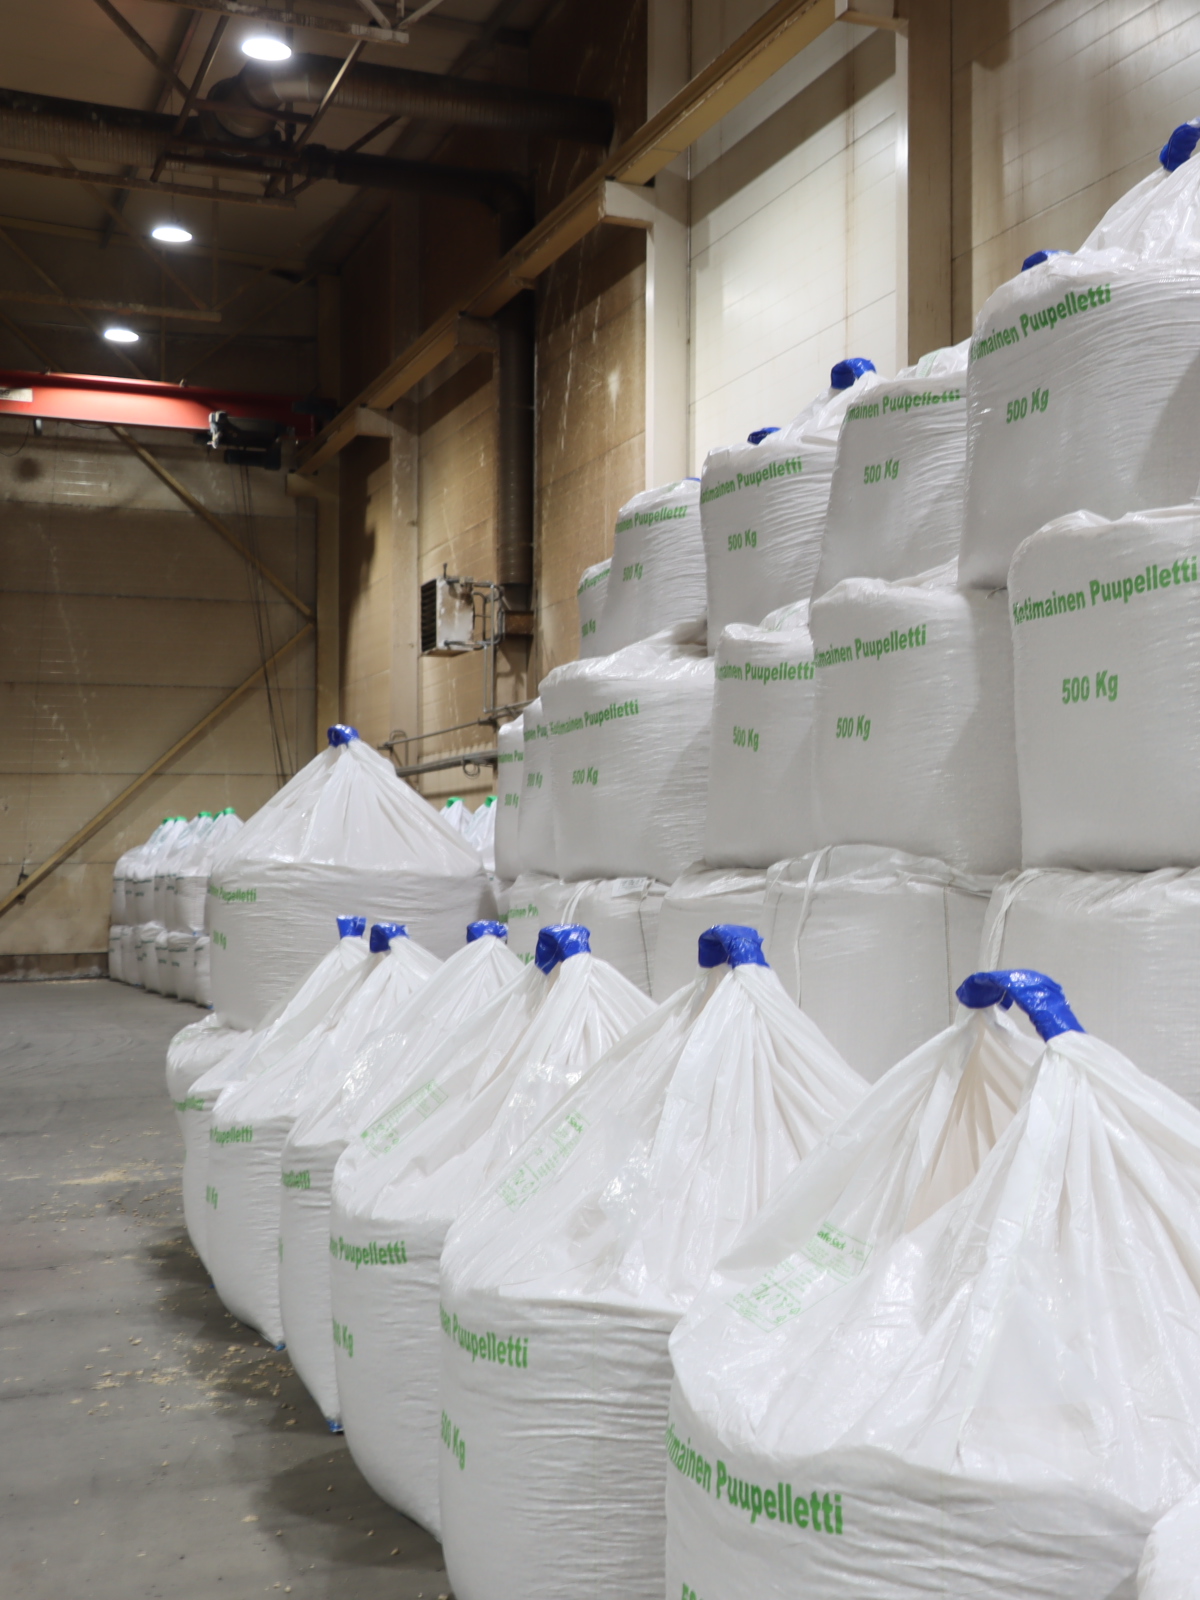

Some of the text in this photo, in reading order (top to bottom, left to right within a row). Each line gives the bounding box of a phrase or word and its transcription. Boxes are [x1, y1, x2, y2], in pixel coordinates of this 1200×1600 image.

[1019, 283, 1112, 337] Puupelletti
[1006, 387, 1050, 424] 500 Kg
[736, 456, 803, 490] Puupelletti
[863, 458, 900, 485] 500 Kg
[727, 528, 758, 552] 500 Kg
[1089, 556, 1198, 605] Puupelletti
[854, 624, 927, 661] Puupelletti
[745, 661, 815, 685] Puupelletti
[1062, 670, 1119, 704] 500 Kg
[584, 699, 639, 728] Puupelletti
[836, 714, 872, 741] 500 Kg
[733, 726, 760, 752] 500 Kg
[571, 766, 599, 786] 500 Kg
[339, 1236, 408, 1270] Puupelletti
[342, 1324, 354, 1358] Kg
[453, 1312, 529, 1369] Puupelletti
[452, 1425, 466, 1470] Kg
[716, 1459, 843, 1535] Puupelletti
